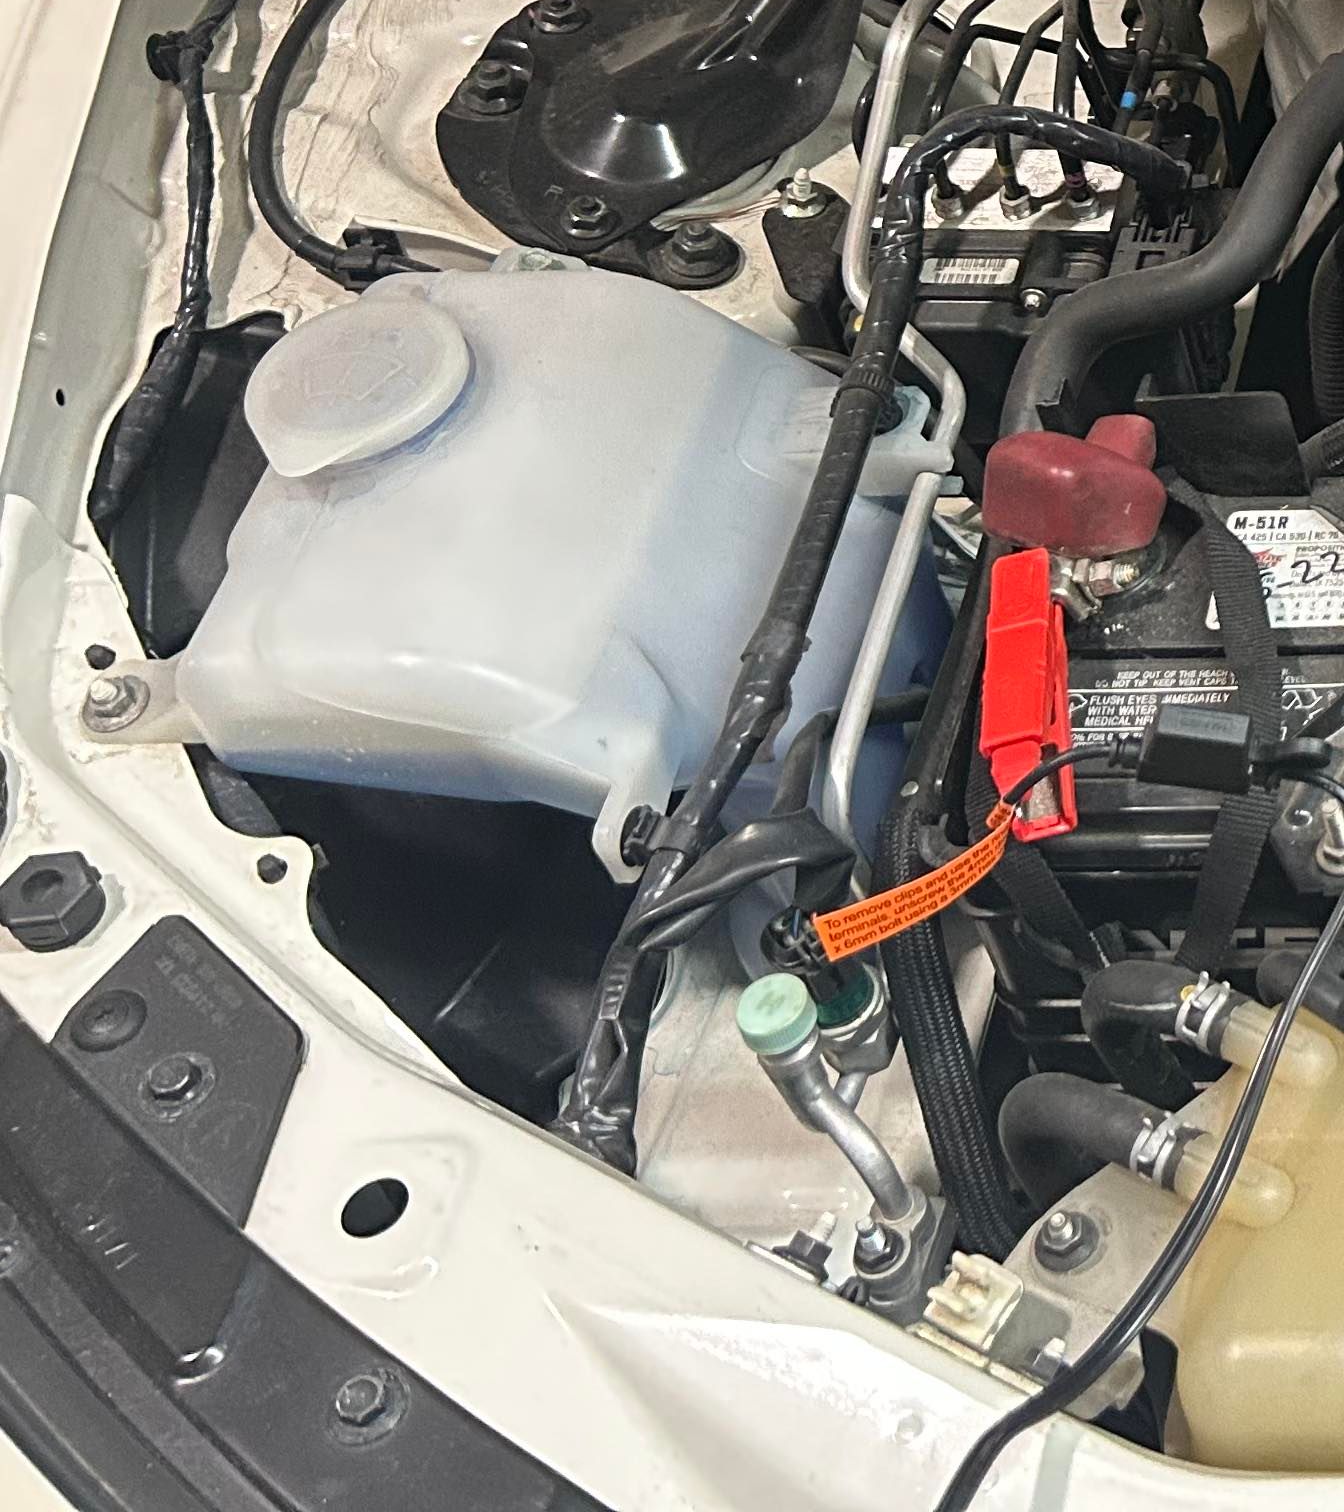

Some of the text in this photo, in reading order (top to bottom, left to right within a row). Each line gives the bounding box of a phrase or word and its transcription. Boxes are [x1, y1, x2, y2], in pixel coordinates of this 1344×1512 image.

[1234, 516, 1289, 530] M-51R
[1117, 671, 1139, 680] KEEP
[1142, 671, 1161, 679] OUT
[1178, 670, 1197, 679] THE
[1089, 695, 1125, 705] FLUSH
[1127, 694, 1158, 705] EYES
[1087, 705, 1157, 716] WITH WATER
[1084, 716, 1131, 727] MEDICAL
[824, 844, 990, 930] To remove clips and use the
[894, 886, 945, 915] unscrew
[947, 872, 966, 887] the
[967, 849, 994, 873] 4mm
[844, 930, 877, 949] 6mm
[879, 918, 903, 934] bolt
[905, 900, 938, 922] using
[949, 873, 977, 896] 3mm
